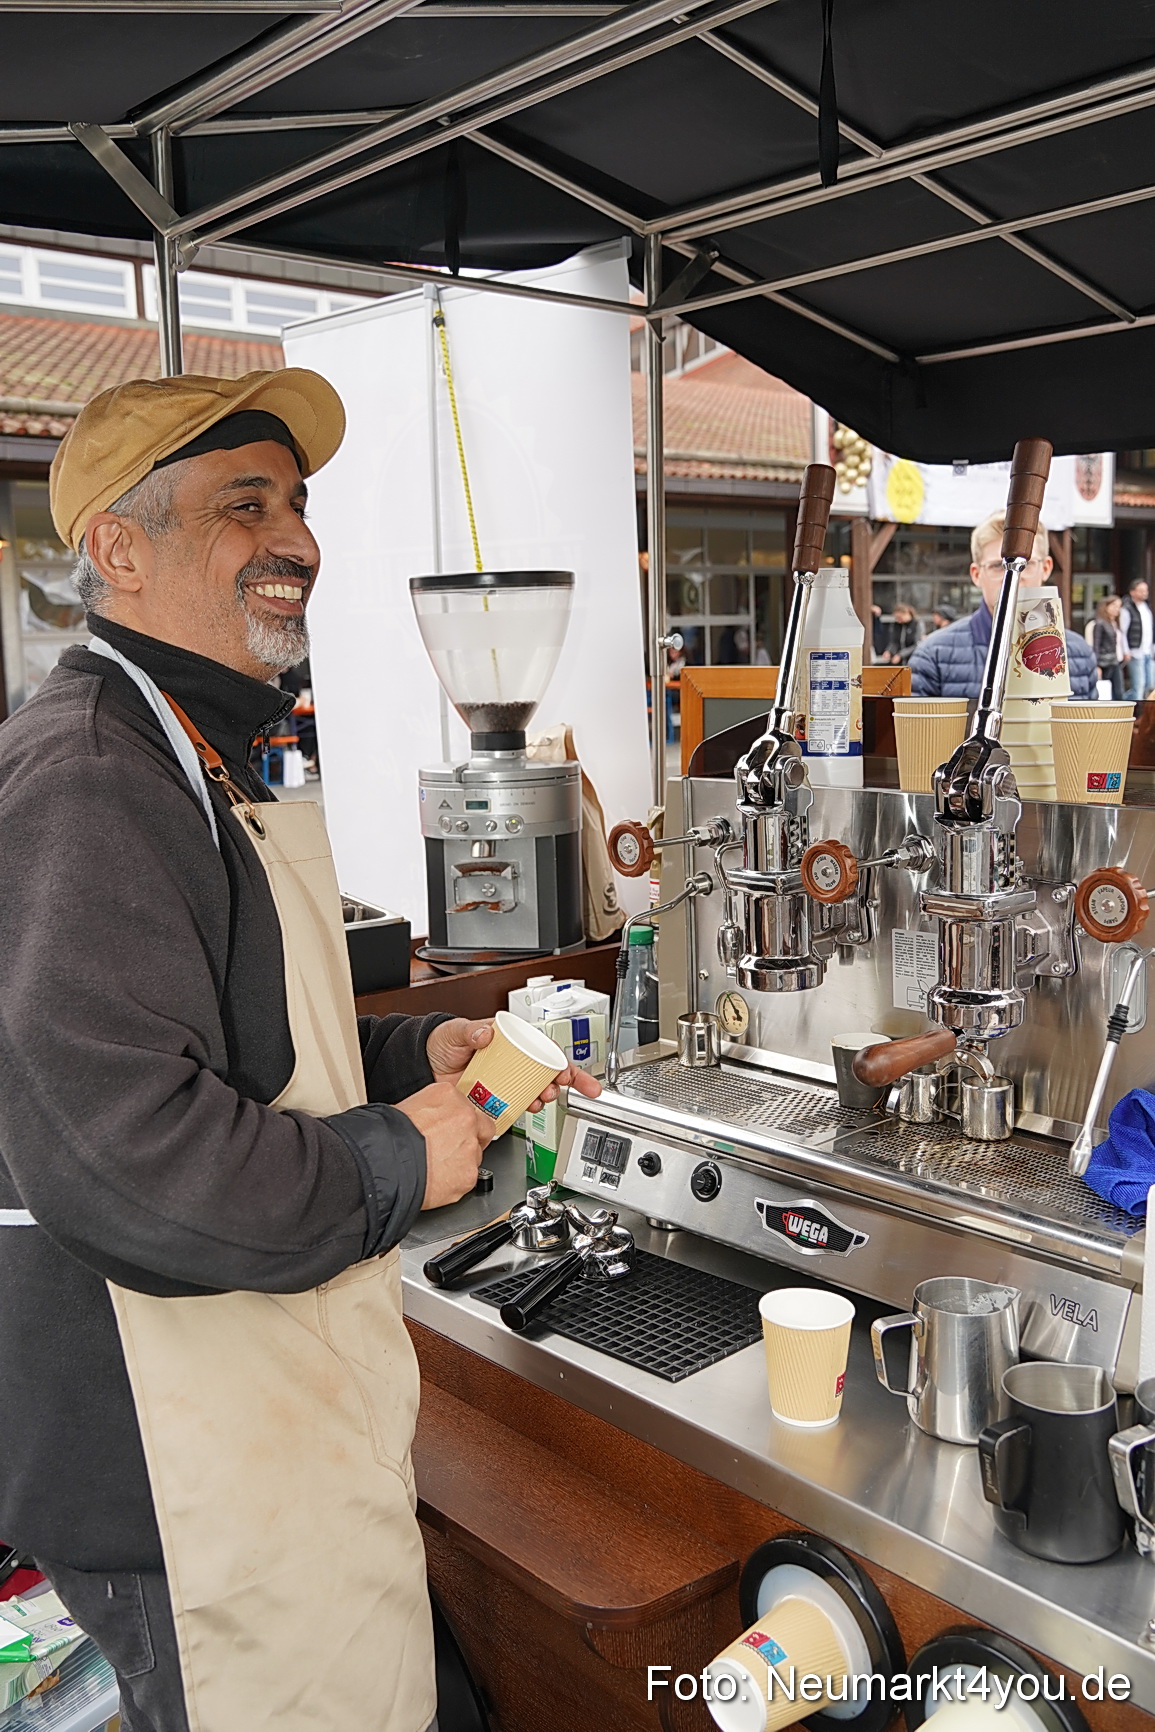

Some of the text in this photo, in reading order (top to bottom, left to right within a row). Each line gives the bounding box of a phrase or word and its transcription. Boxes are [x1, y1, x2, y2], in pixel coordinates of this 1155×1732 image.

[1097, 886, 1115, 895] VAPEUR
[1090, 898, 1099, 915] STEAM
[1117, 894, 1126, 914] VAPORE
[788, 1215, 829, 1244] WEGA
[1050, 1293, 1099, 1333] VELA
